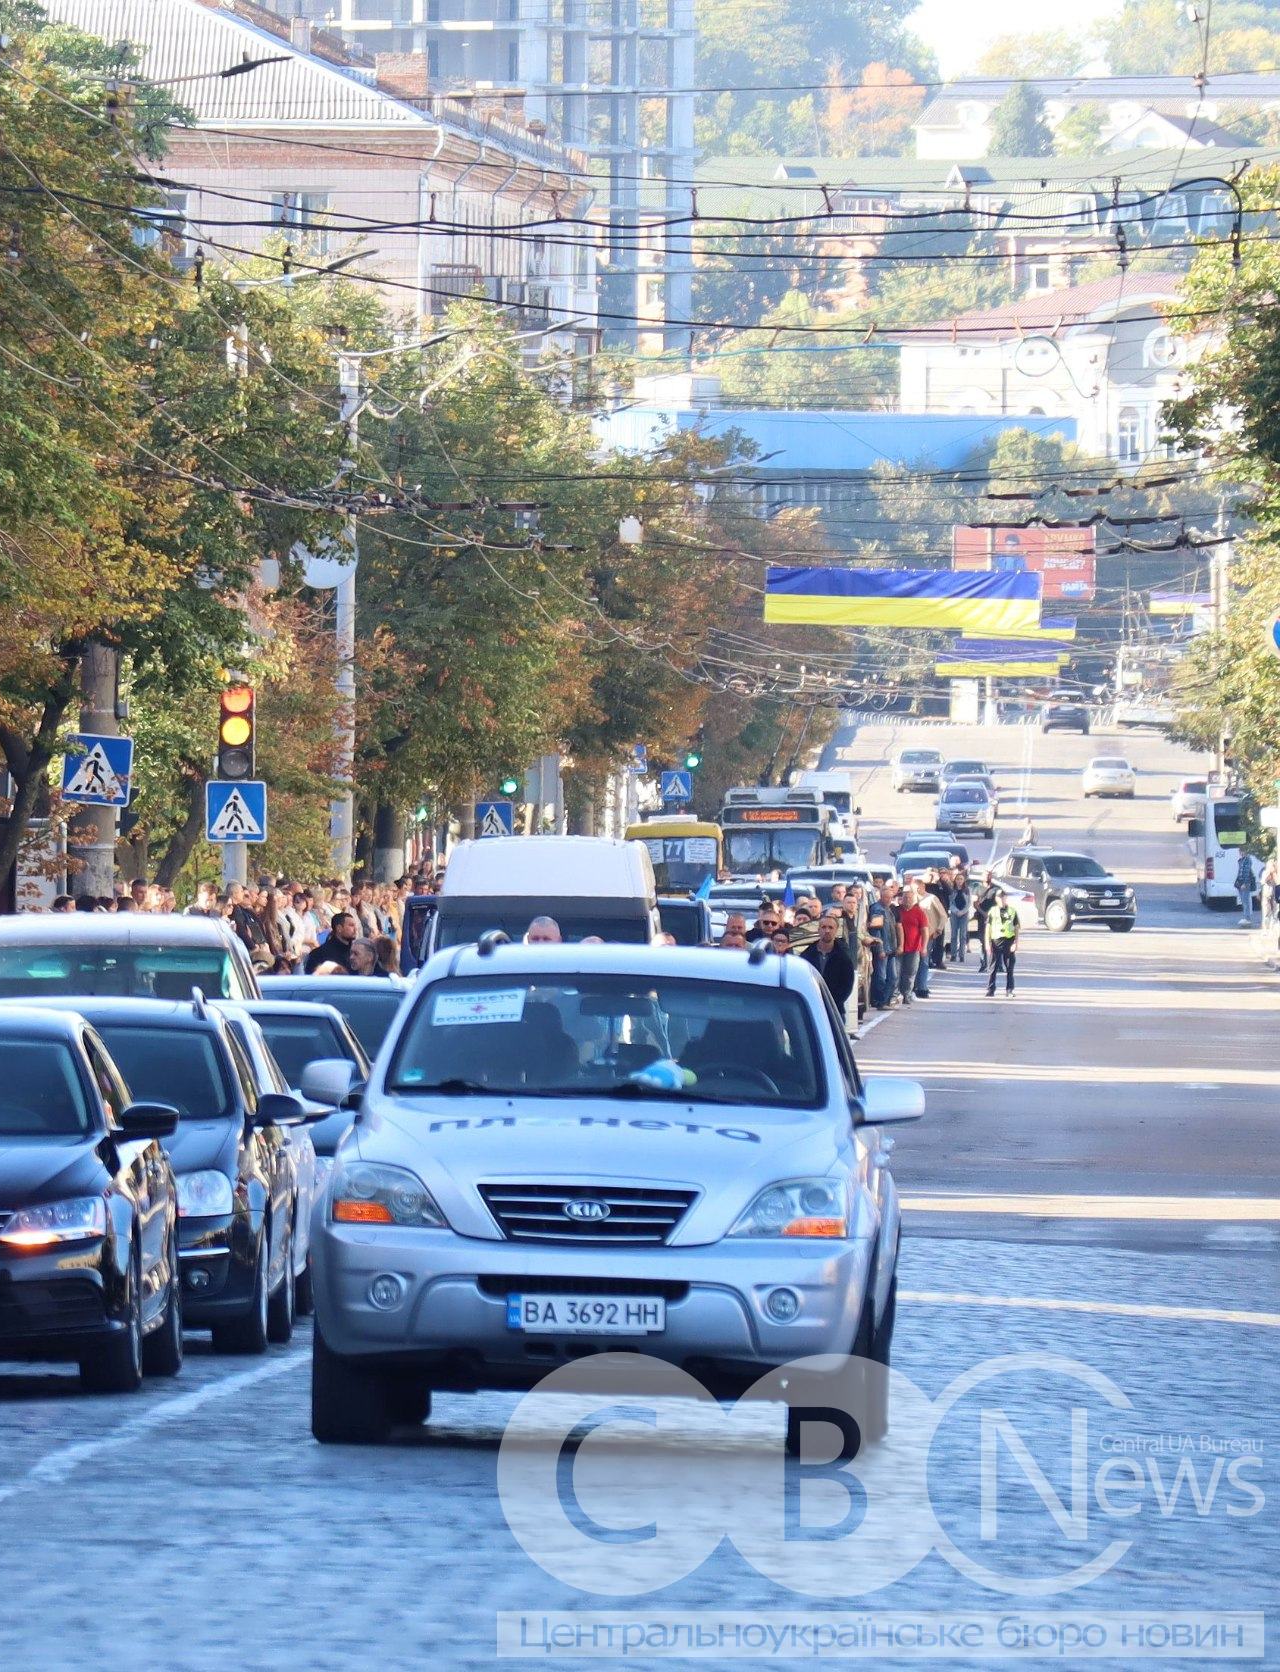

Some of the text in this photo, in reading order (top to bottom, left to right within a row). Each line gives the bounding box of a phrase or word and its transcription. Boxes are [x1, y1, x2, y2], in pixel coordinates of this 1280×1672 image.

[664, 840, 683, 856] 77
[570, 1203, 602, 1217] KIA
[567, 1303, 619, 1324] 3692
